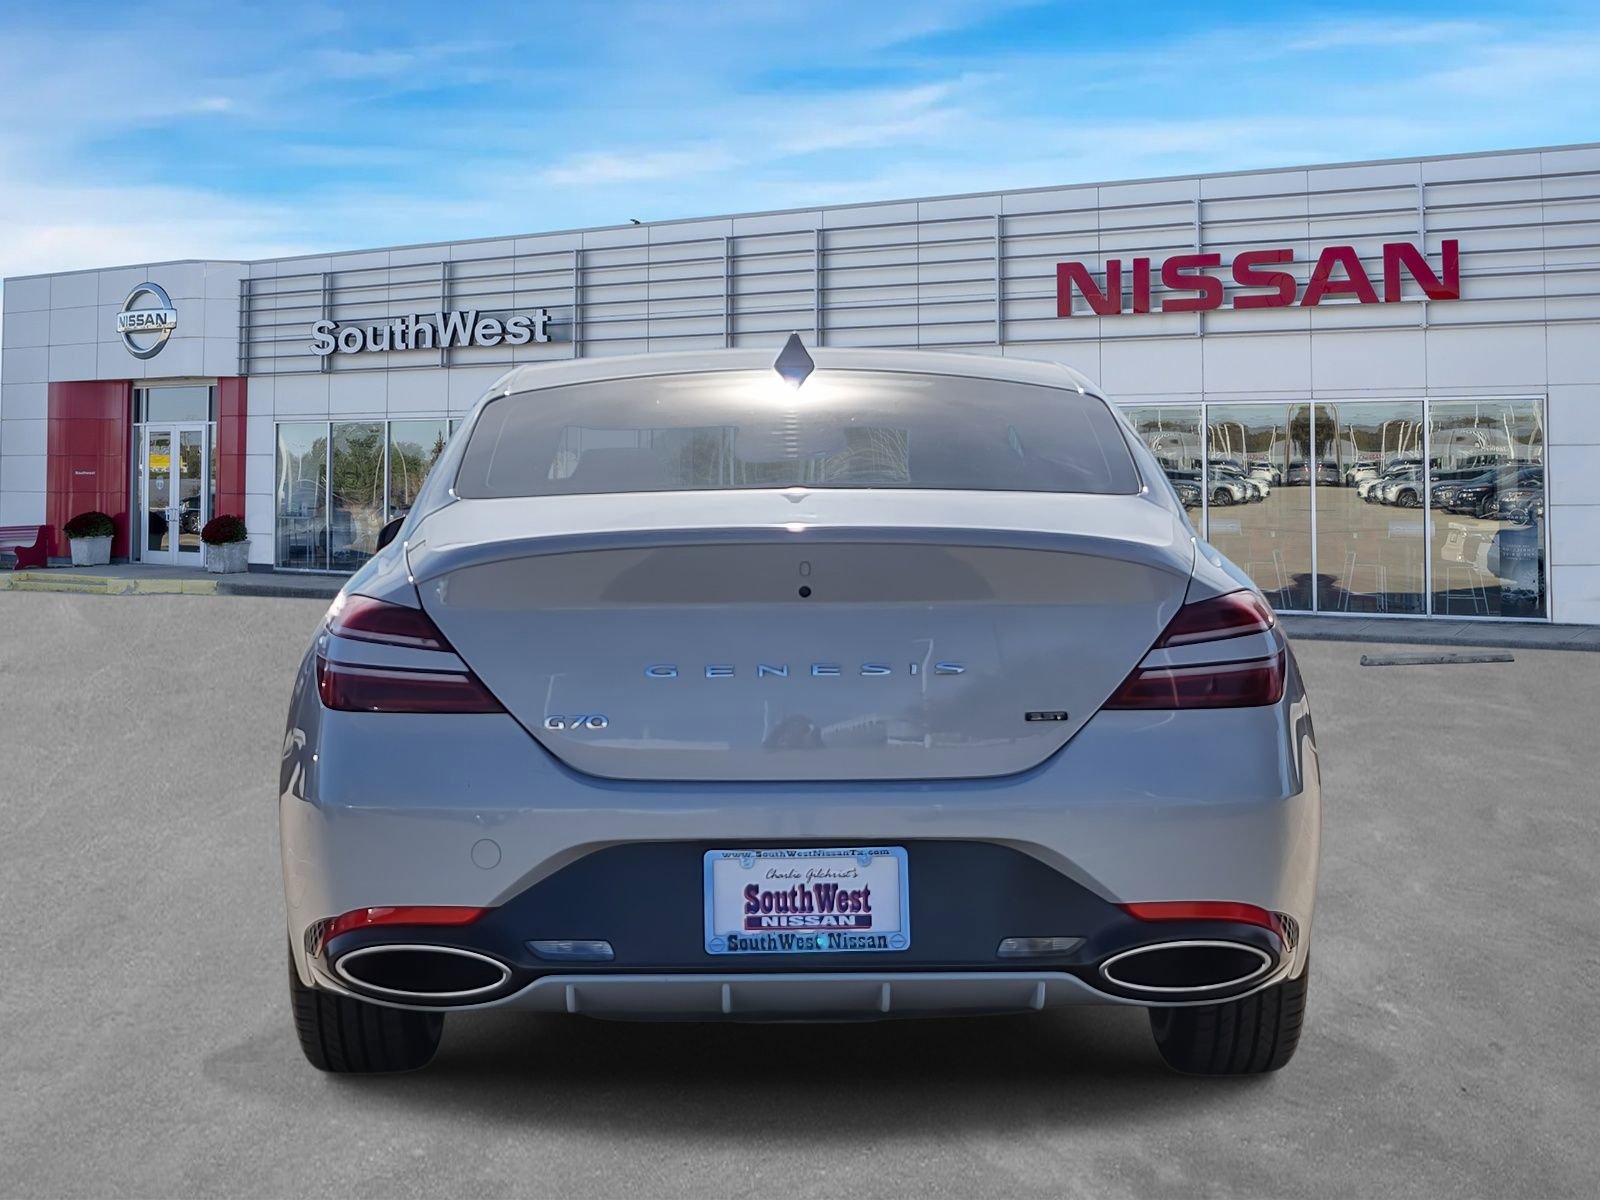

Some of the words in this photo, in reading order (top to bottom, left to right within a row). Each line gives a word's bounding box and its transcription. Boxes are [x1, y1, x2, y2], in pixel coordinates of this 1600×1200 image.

[1056, 239, 1460, 317] NISSAN
[119, 313, 167, 328] NISSAN
[310, 308, 551, 356] SouthWest
[644, 662, 967, 678] GENESIS
[543, 714, 609, 730] G70
[766, 868, 802, 880] Charlie
[806, 868, 859, 884] Gilchrist's
[743, 882, 872, 914] SouthWest
[761, 915, 856, 927] NISSAN
[728, 933, 823, 952] SouthWest
[828, 932, 889, 950] Nissan
